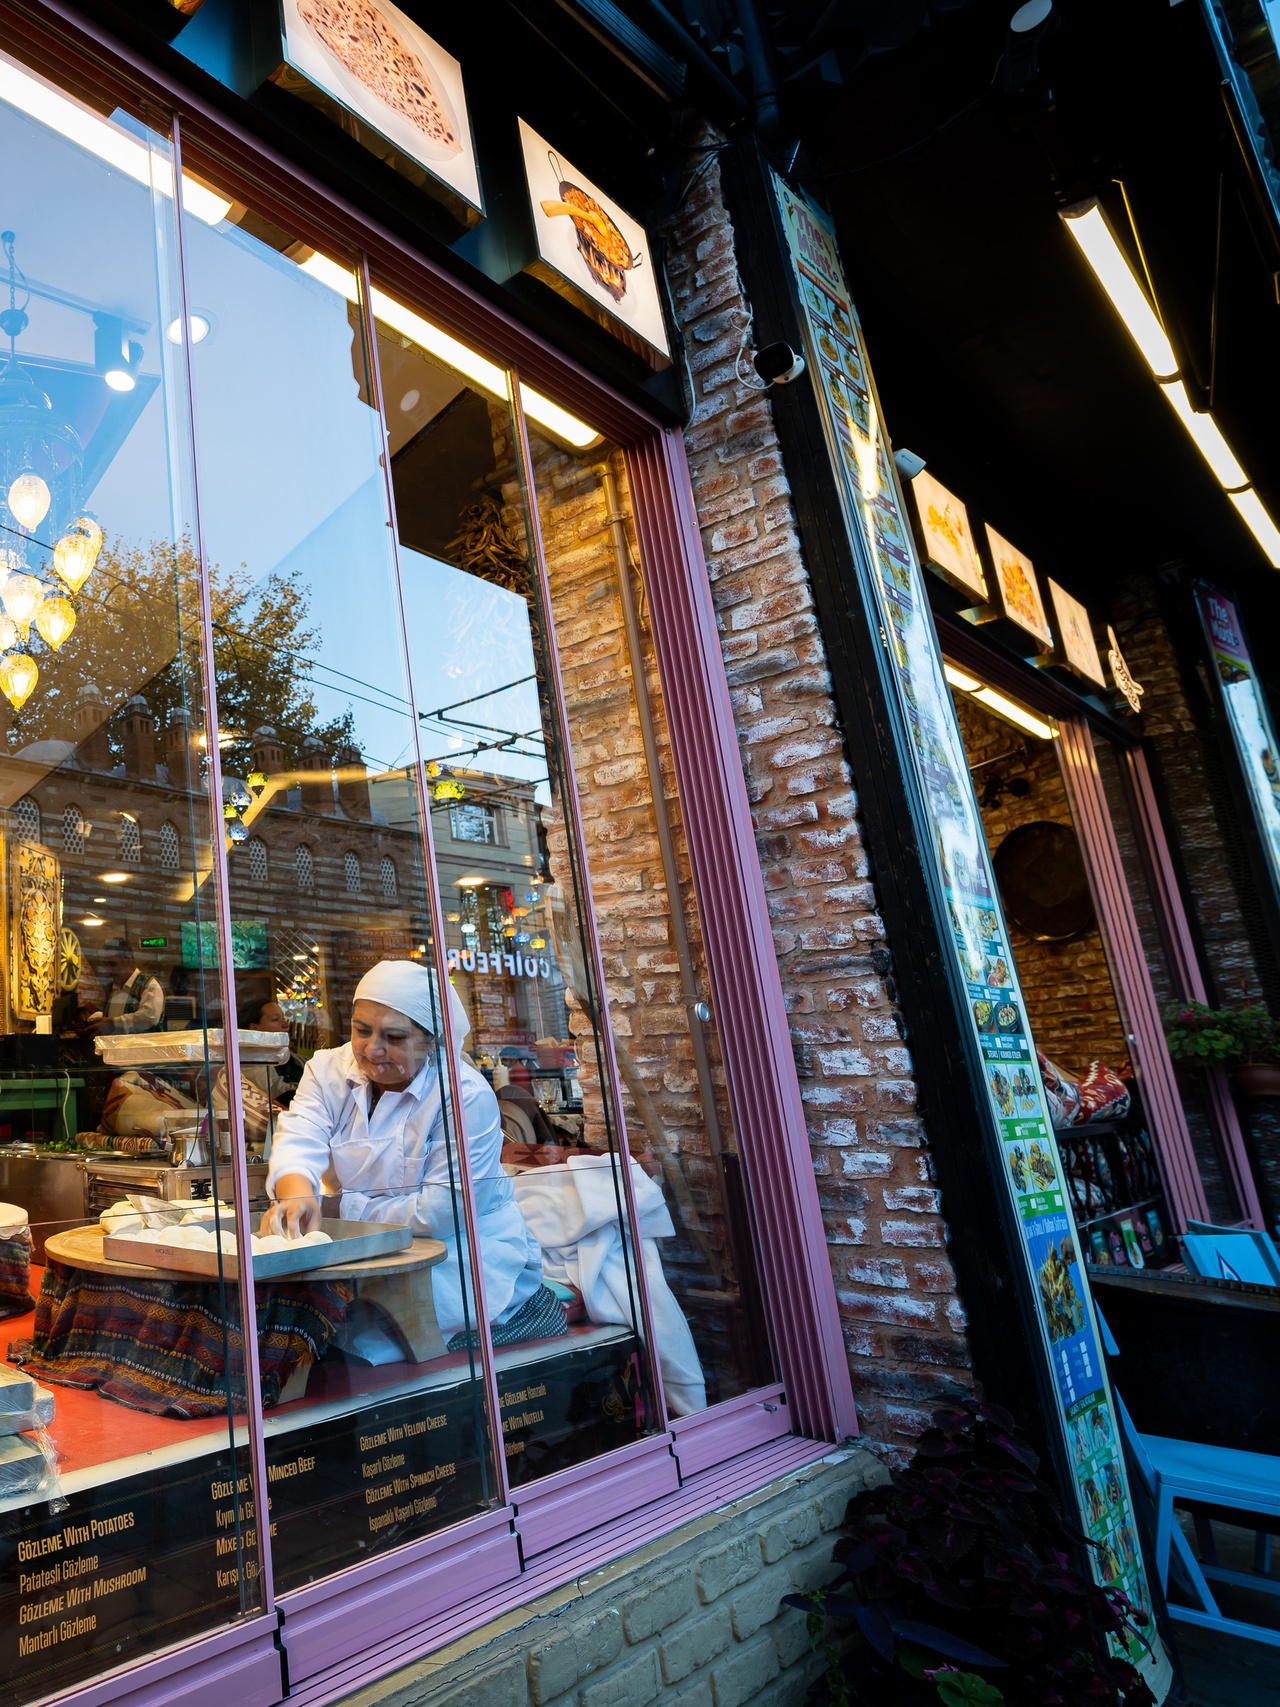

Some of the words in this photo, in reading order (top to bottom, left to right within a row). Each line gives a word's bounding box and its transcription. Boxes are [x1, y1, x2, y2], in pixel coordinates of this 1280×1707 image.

[794, 203, 823, 250] The
[797, 228, 834, 280] Must
[20, 1563, 61, 1595] Patatesli
[62, 1554, 99, 1581] Gözleme
[19, 1625, 58, 1658] Mantarlı
[60, 1614, 97, 1642] Gözleme
